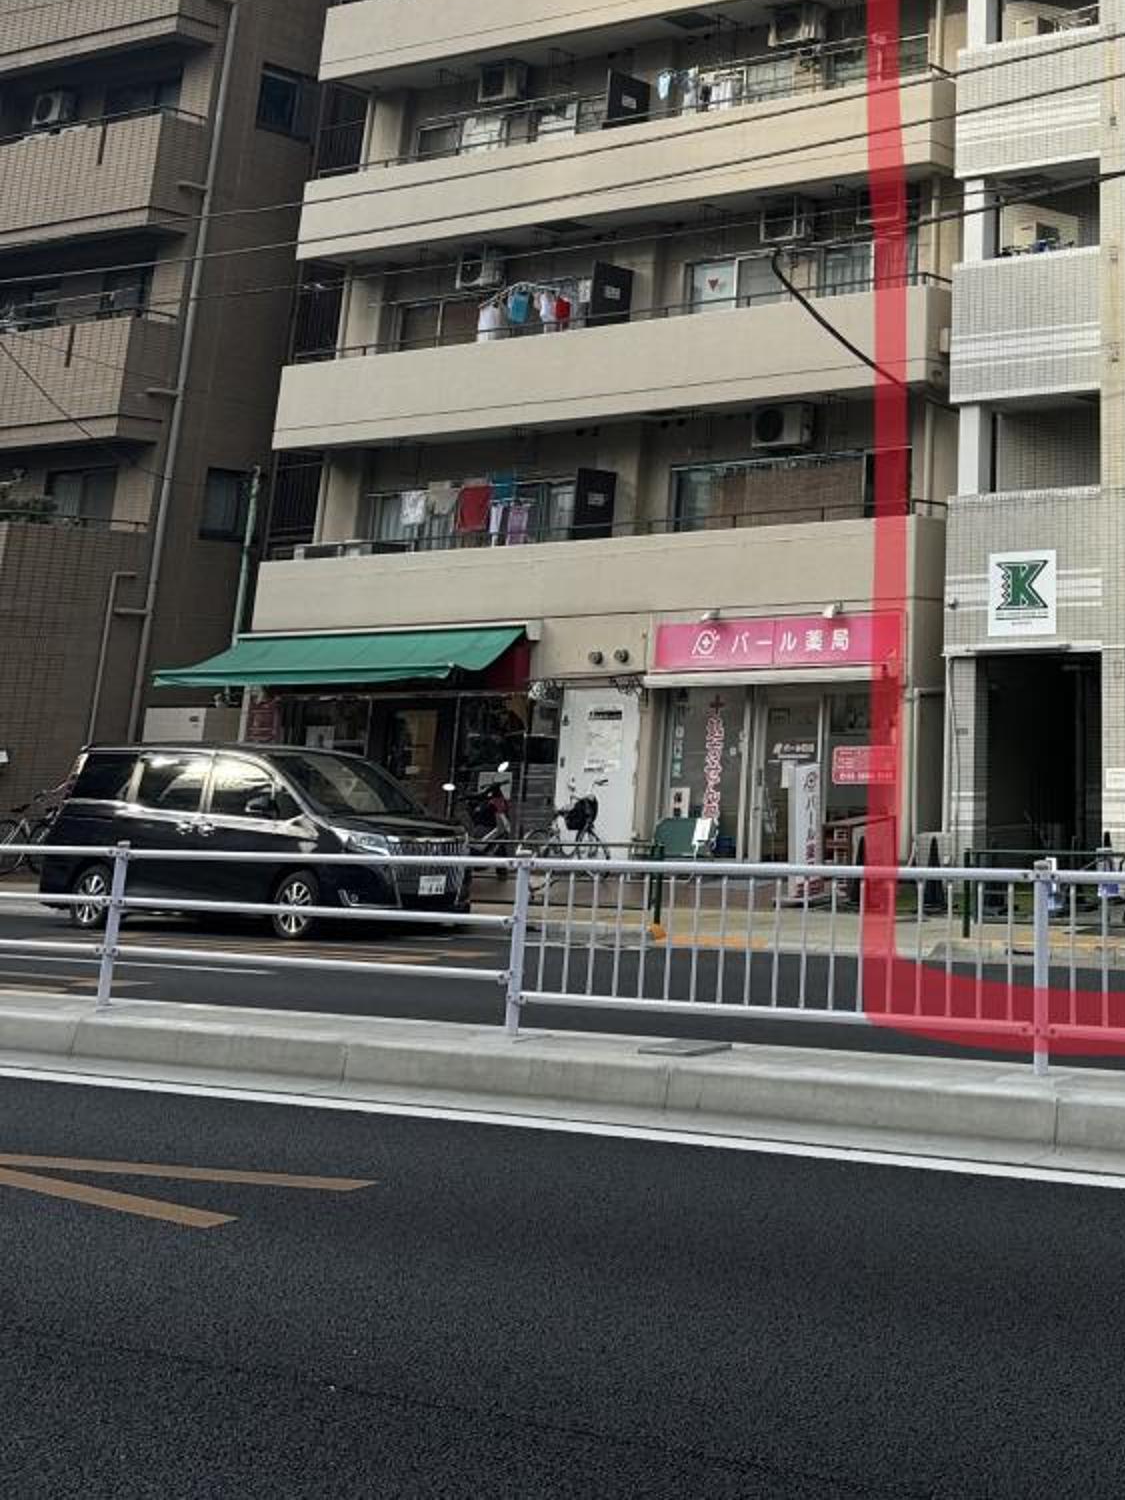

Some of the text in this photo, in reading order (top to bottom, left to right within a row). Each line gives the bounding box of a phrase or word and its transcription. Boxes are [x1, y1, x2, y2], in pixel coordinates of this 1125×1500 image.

[731, 629, 849, 653] パール薬局
